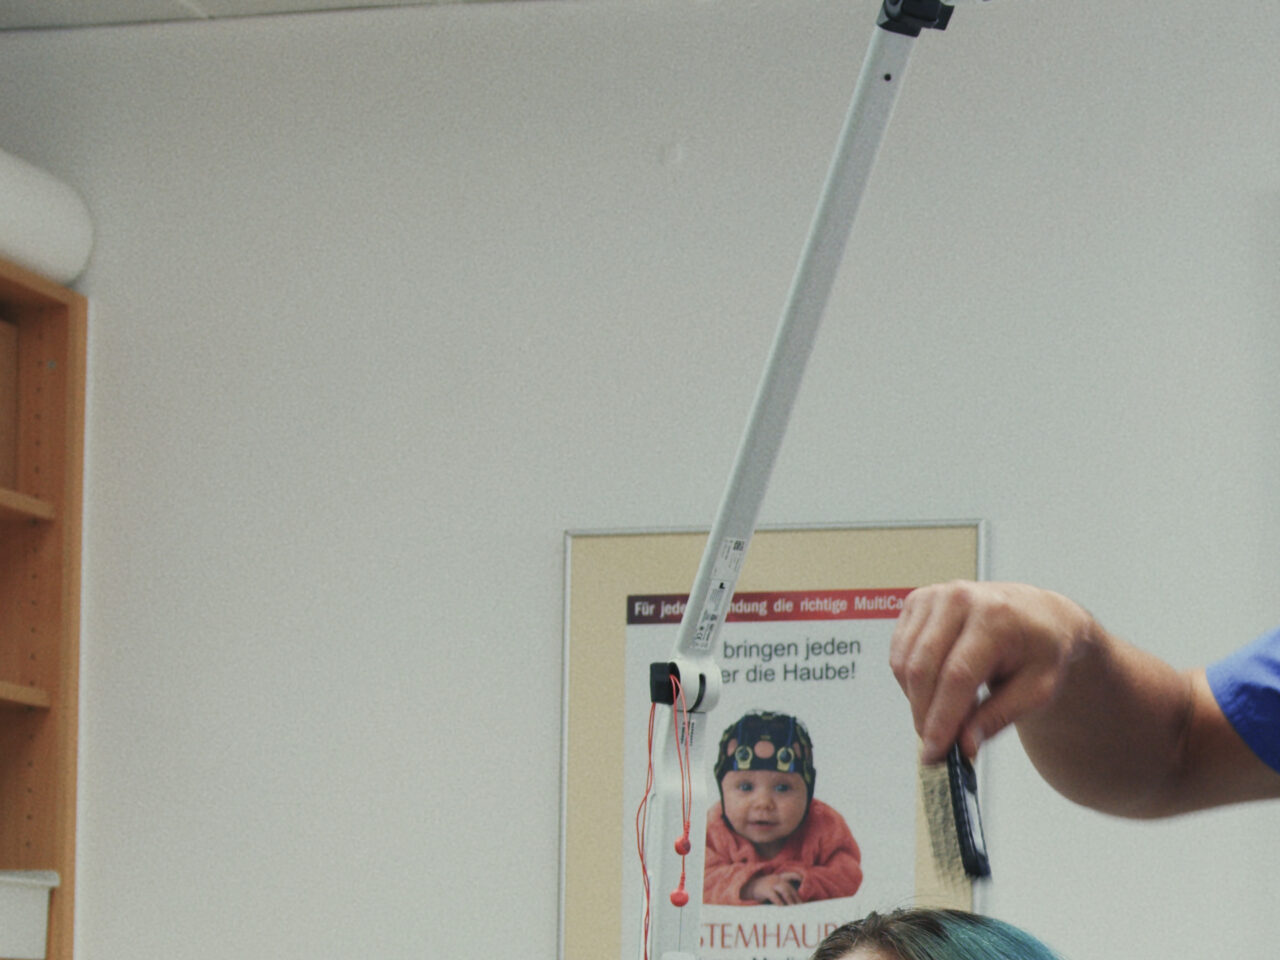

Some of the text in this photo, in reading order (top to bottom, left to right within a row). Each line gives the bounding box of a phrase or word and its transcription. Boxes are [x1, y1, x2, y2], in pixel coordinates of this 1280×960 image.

[634, 601, 655, 616] Für
[728, 599, 767, 616] ndung
[773, 597, 794, 613] die
[800, 596, 848, 615] richtige
[854, 595, 904, 611] MultiCa
[723, 637, 861, 662] bringen jeden
[721, 661, 856, 684] er die Haube!
[700, 922, 838, 949] TEMHAU
